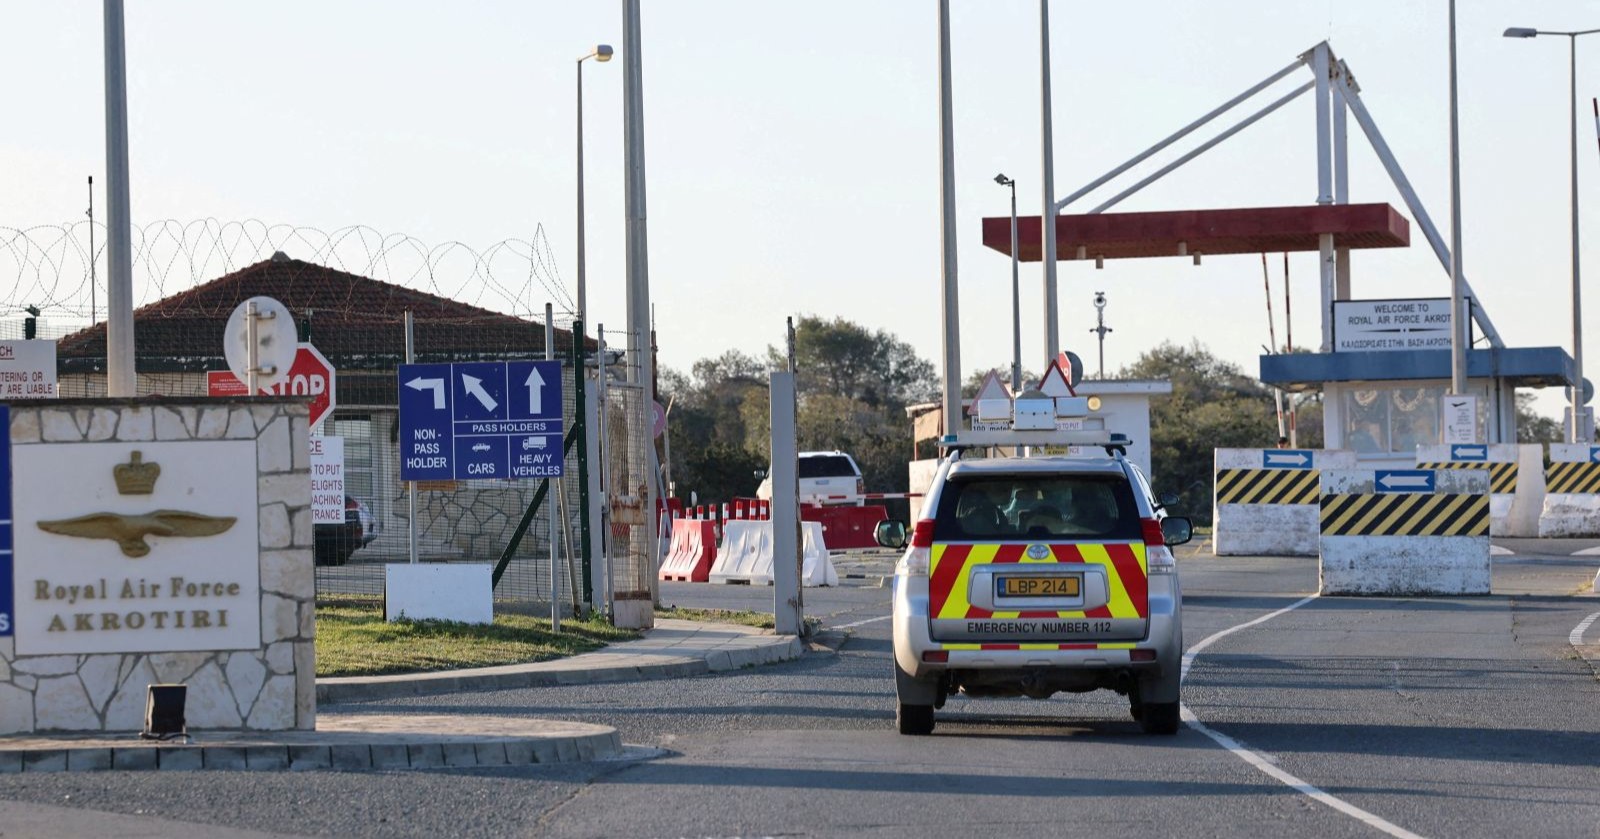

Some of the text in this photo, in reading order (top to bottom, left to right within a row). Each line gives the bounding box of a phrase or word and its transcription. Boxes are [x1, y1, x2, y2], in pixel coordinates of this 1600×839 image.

[1374, 303, 1429, 314] WELCOME TO
[1348, 316, 1373, 325] ROYAL
[1377, 316, 1390, 324] AIR
[1394, 315, 1419, 324] FORCE
[32, 371, 43, 382] OR
[8, 384, 22, 394] ARE
[27, 384, 52, 394] LIABLE
[262, 374, 325, 396] TOP
[472, 422, 547, 433] PASS HOLDERS
[414, 443, 440, 454] PASS
[407, 457, 447, 469] HOLDER
[519, 454, 552, 464] HEAVY
[314, 464, 325, 475] TO
[326, 464, 340, 475] PUT
[467, 463, 495, 474] CARS
[513, 465, 560, 476] VEHICLES
[34, 577, 241, 605] Royal Air Force
[1008, 580, 1067, 593] LBP 214
[48, 609, 229, 632] AKROTIRI
[967, 622, 1111, 633] EMERGENCY NUMBER 112
